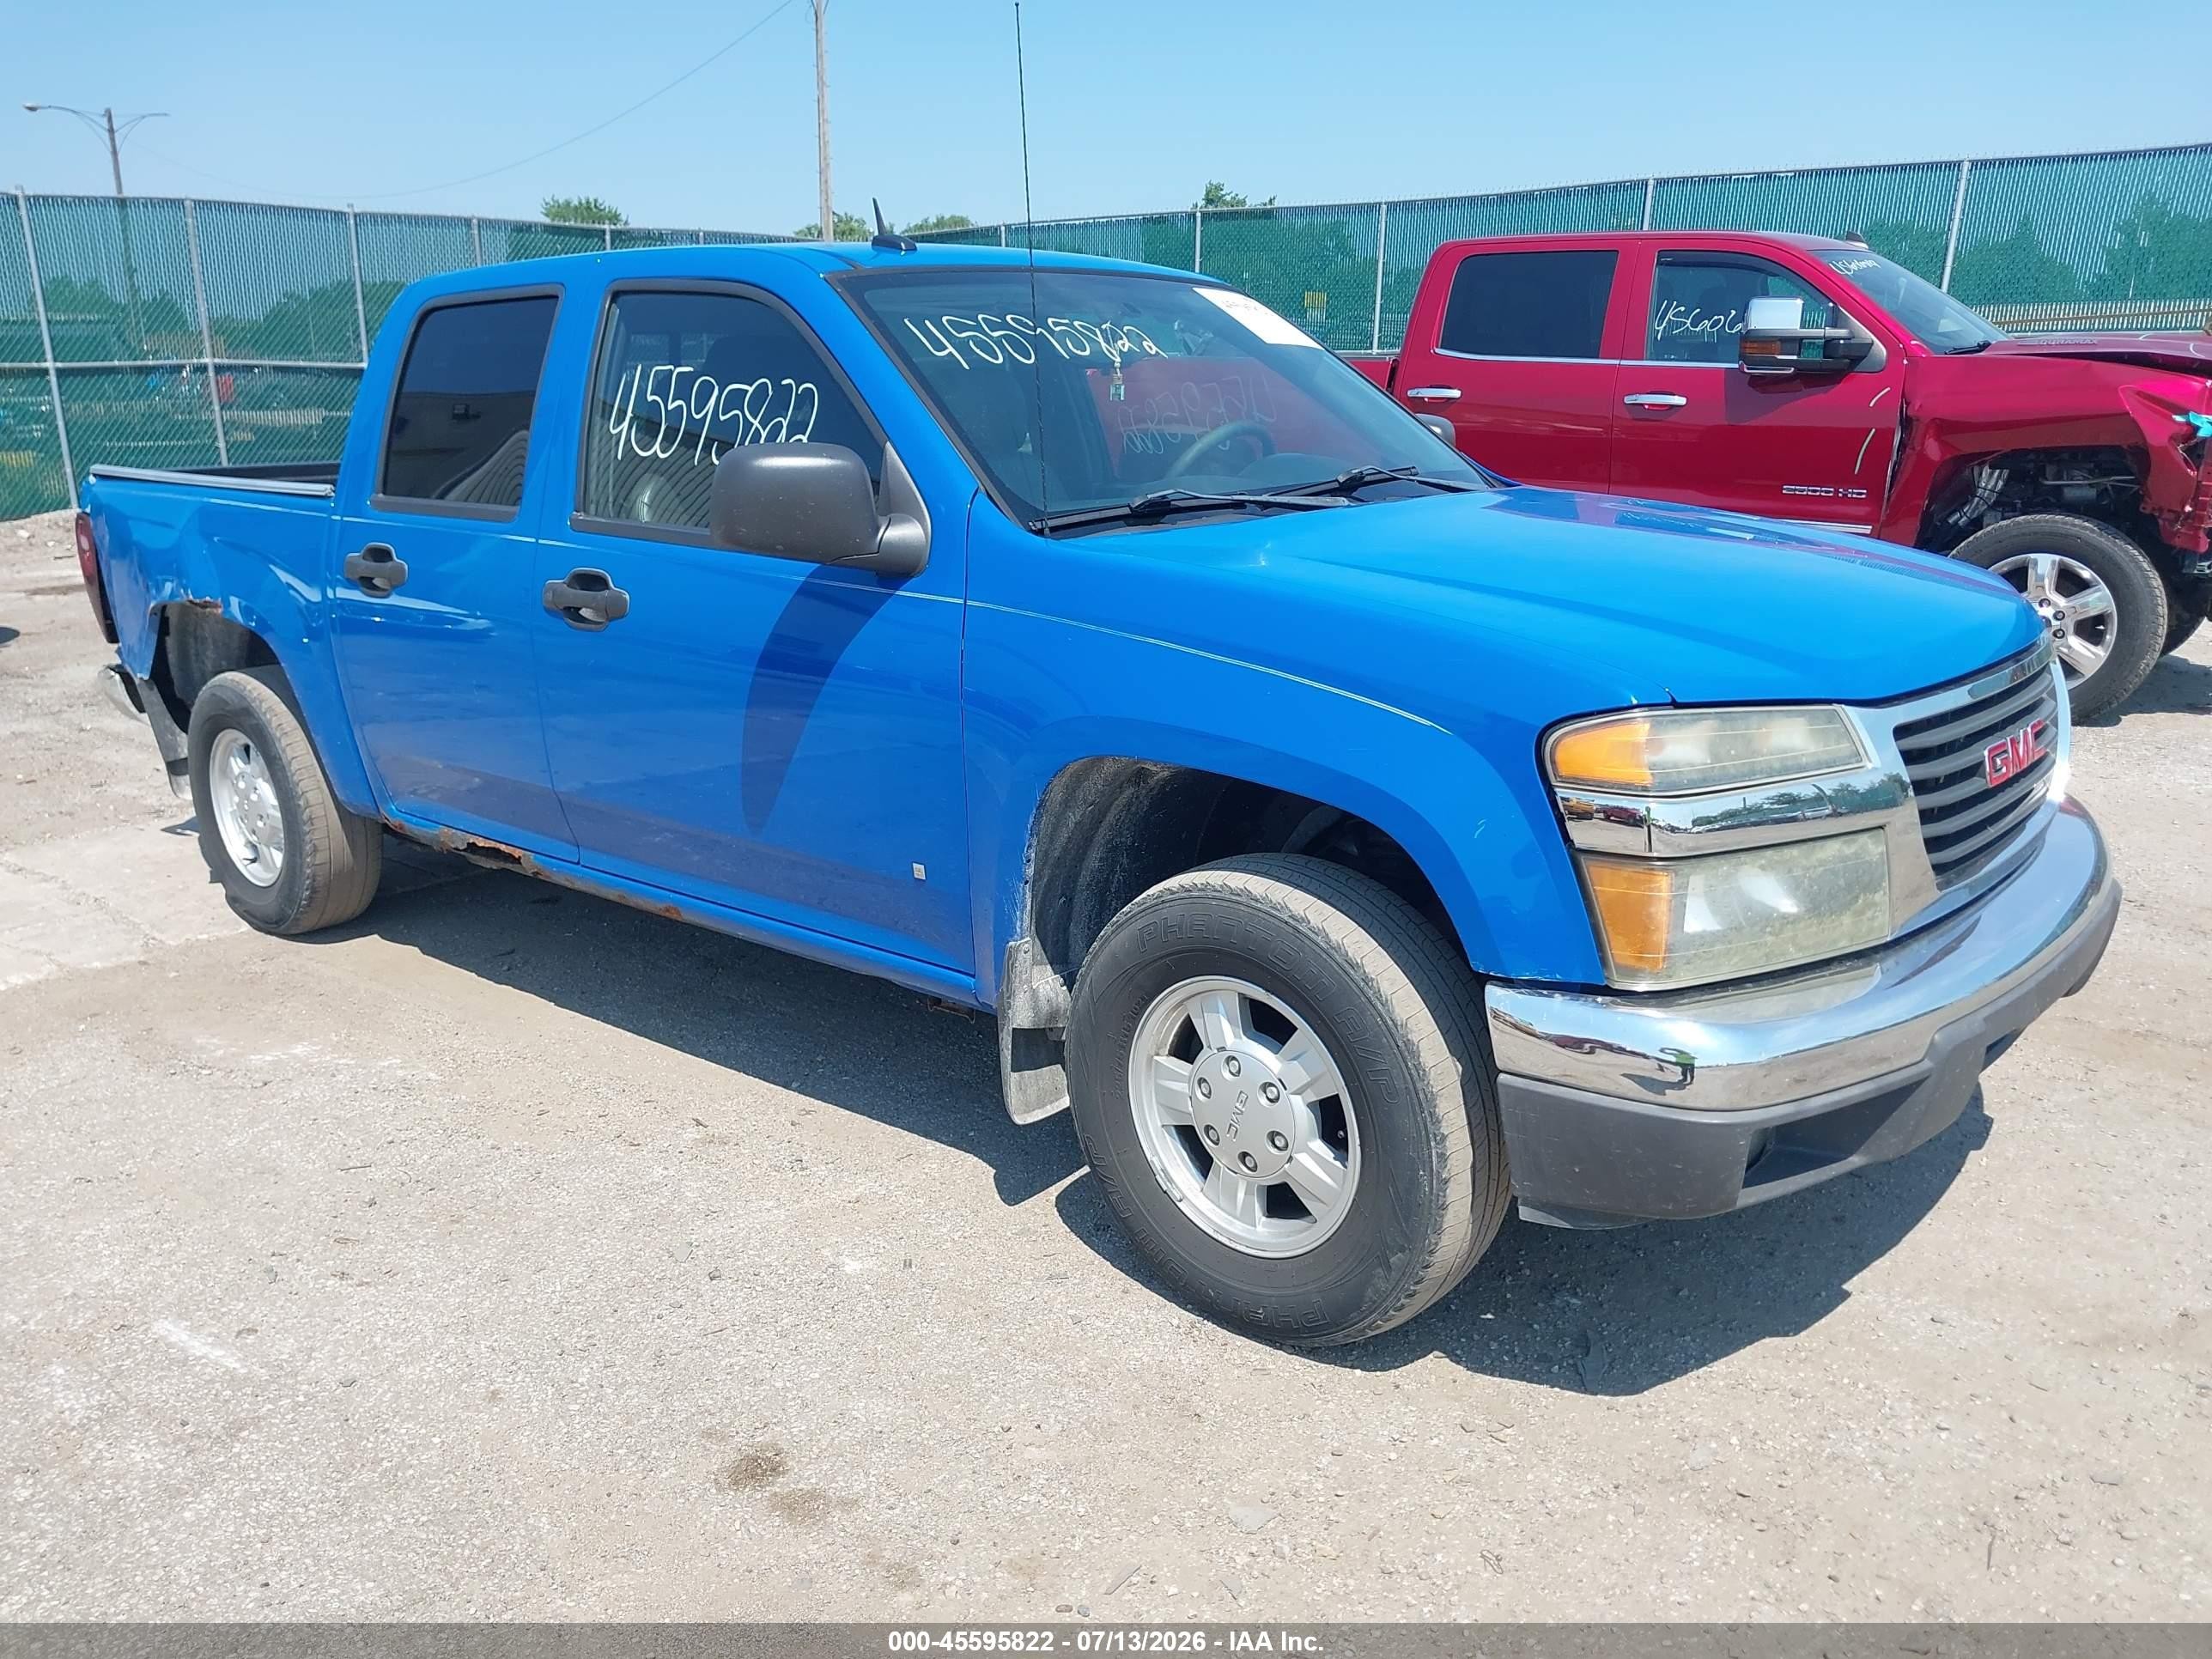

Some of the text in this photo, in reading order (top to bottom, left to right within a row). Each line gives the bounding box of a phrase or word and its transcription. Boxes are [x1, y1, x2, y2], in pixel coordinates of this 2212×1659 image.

[903, 313, 1169, 370] 45595822
[609, 362, 818, 466] 45595822
[1838, 488, 1867, 498] HD
[1984, 718, 2047, 788] GMC
[1136, 912, 1336, 1002] PHANTOM
[1226, 1090, 1249, 1141] GMC
